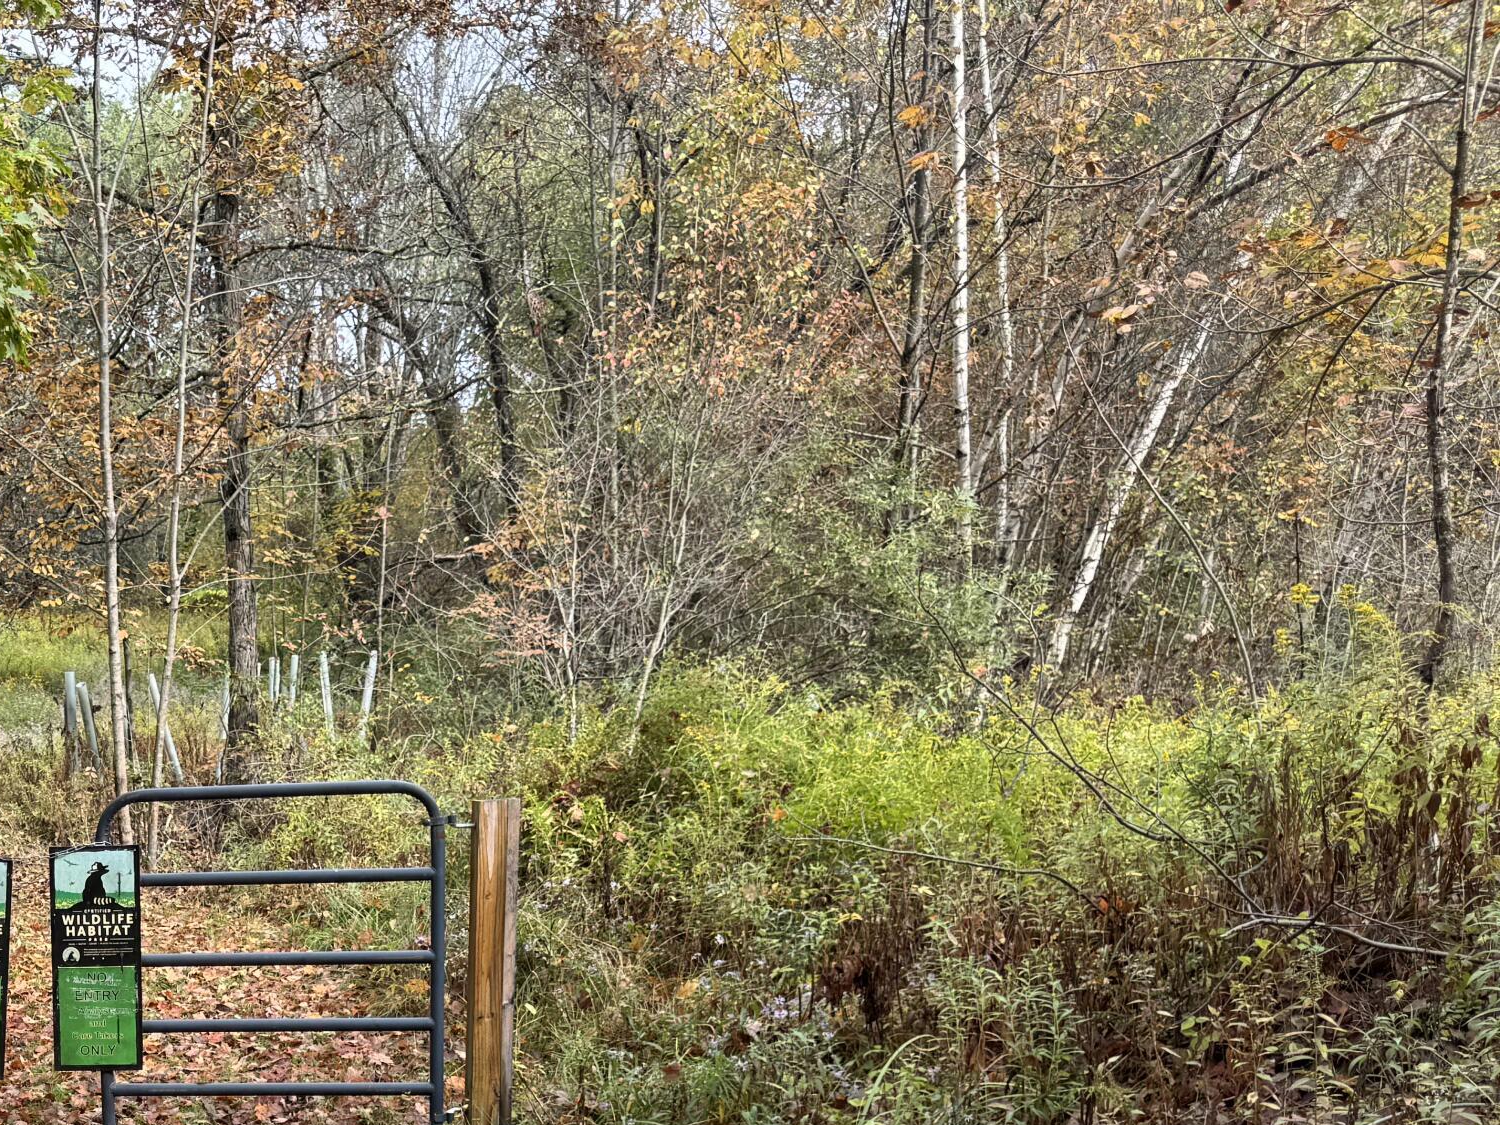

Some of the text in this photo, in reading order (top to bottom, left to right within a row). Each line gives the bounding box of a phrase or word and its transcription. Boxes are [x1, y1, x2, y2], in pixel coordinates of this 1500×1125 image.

[61, 913, 134, 926] WILDLIFE
[65, 925, 131, 937] HABITAT
[87, 972, 107, 983] NO
[75, 990, 120, 1001] ENTRY
[89, 1019, 107, 1028] and
[80, 1045, 116, 1056] ONLY
